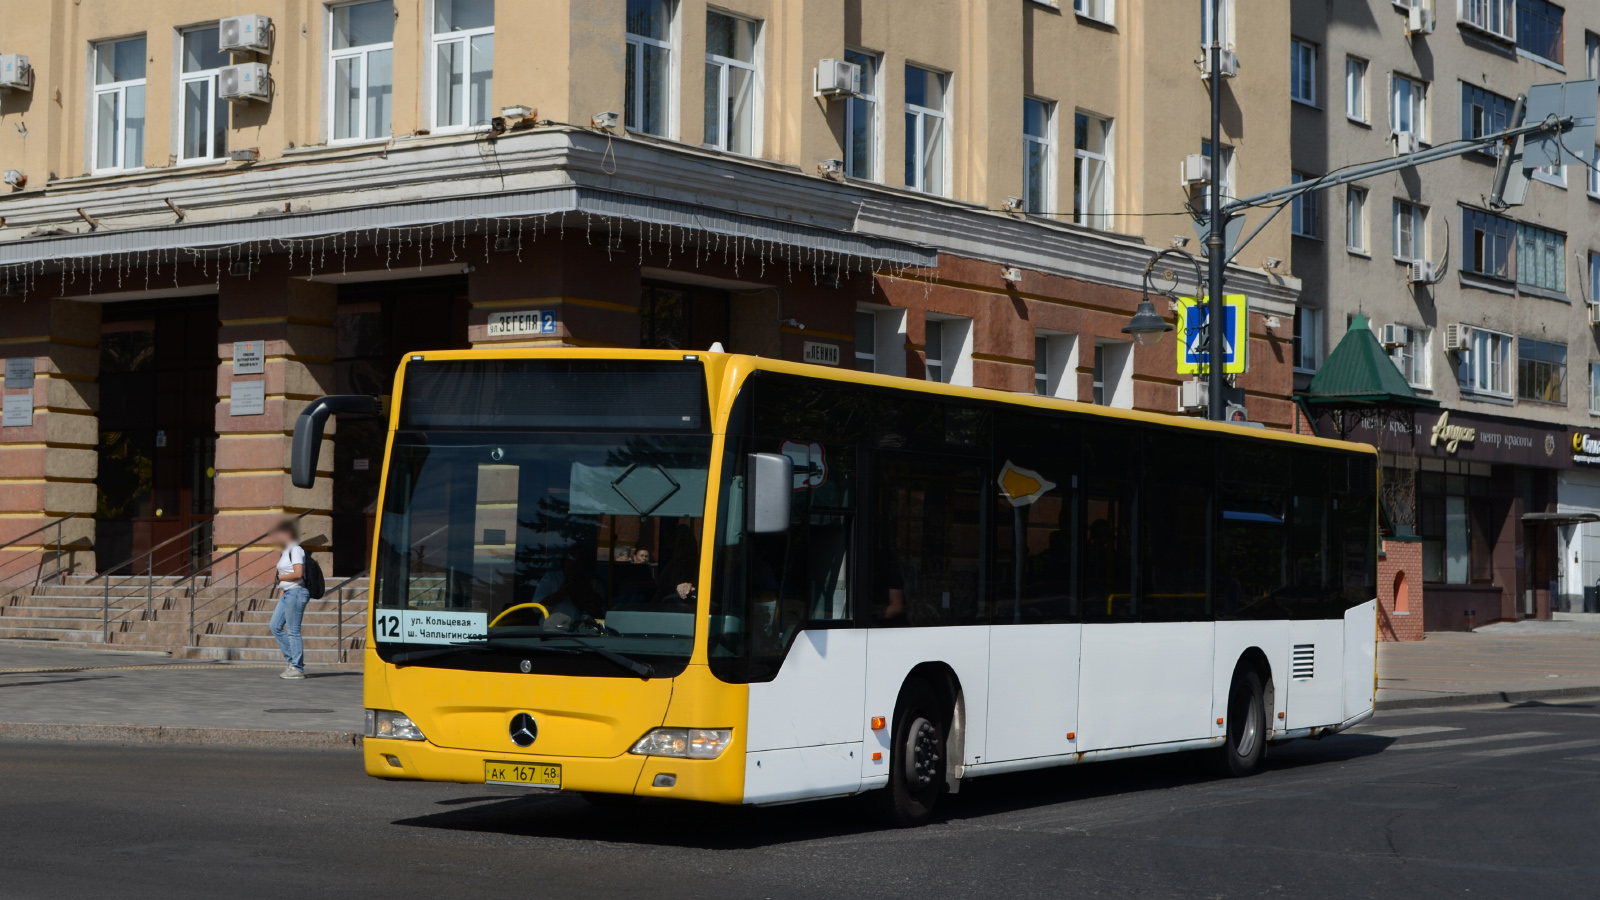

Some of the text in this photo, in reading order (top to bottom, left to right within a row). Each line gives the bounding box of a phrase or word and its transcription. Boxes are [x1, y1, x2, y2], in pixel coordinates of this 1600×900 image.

[499, 314, 538, 332] ЗЕГЕЛЯ
[543, 314, 553, 331] 2
[811, 345, 838, 363] ЛЕНИНА
[1480, 431, 1533, 450] центр красоты
[377, 615, 400, 638] 12
[410, 617, 423, 626] ул.
[425, 616, 472, 628] Кольцевая
[407, 630, 418, 638] ш.
[512, 766, 536, 782] 167
[543, 767, 557, 779] 48
